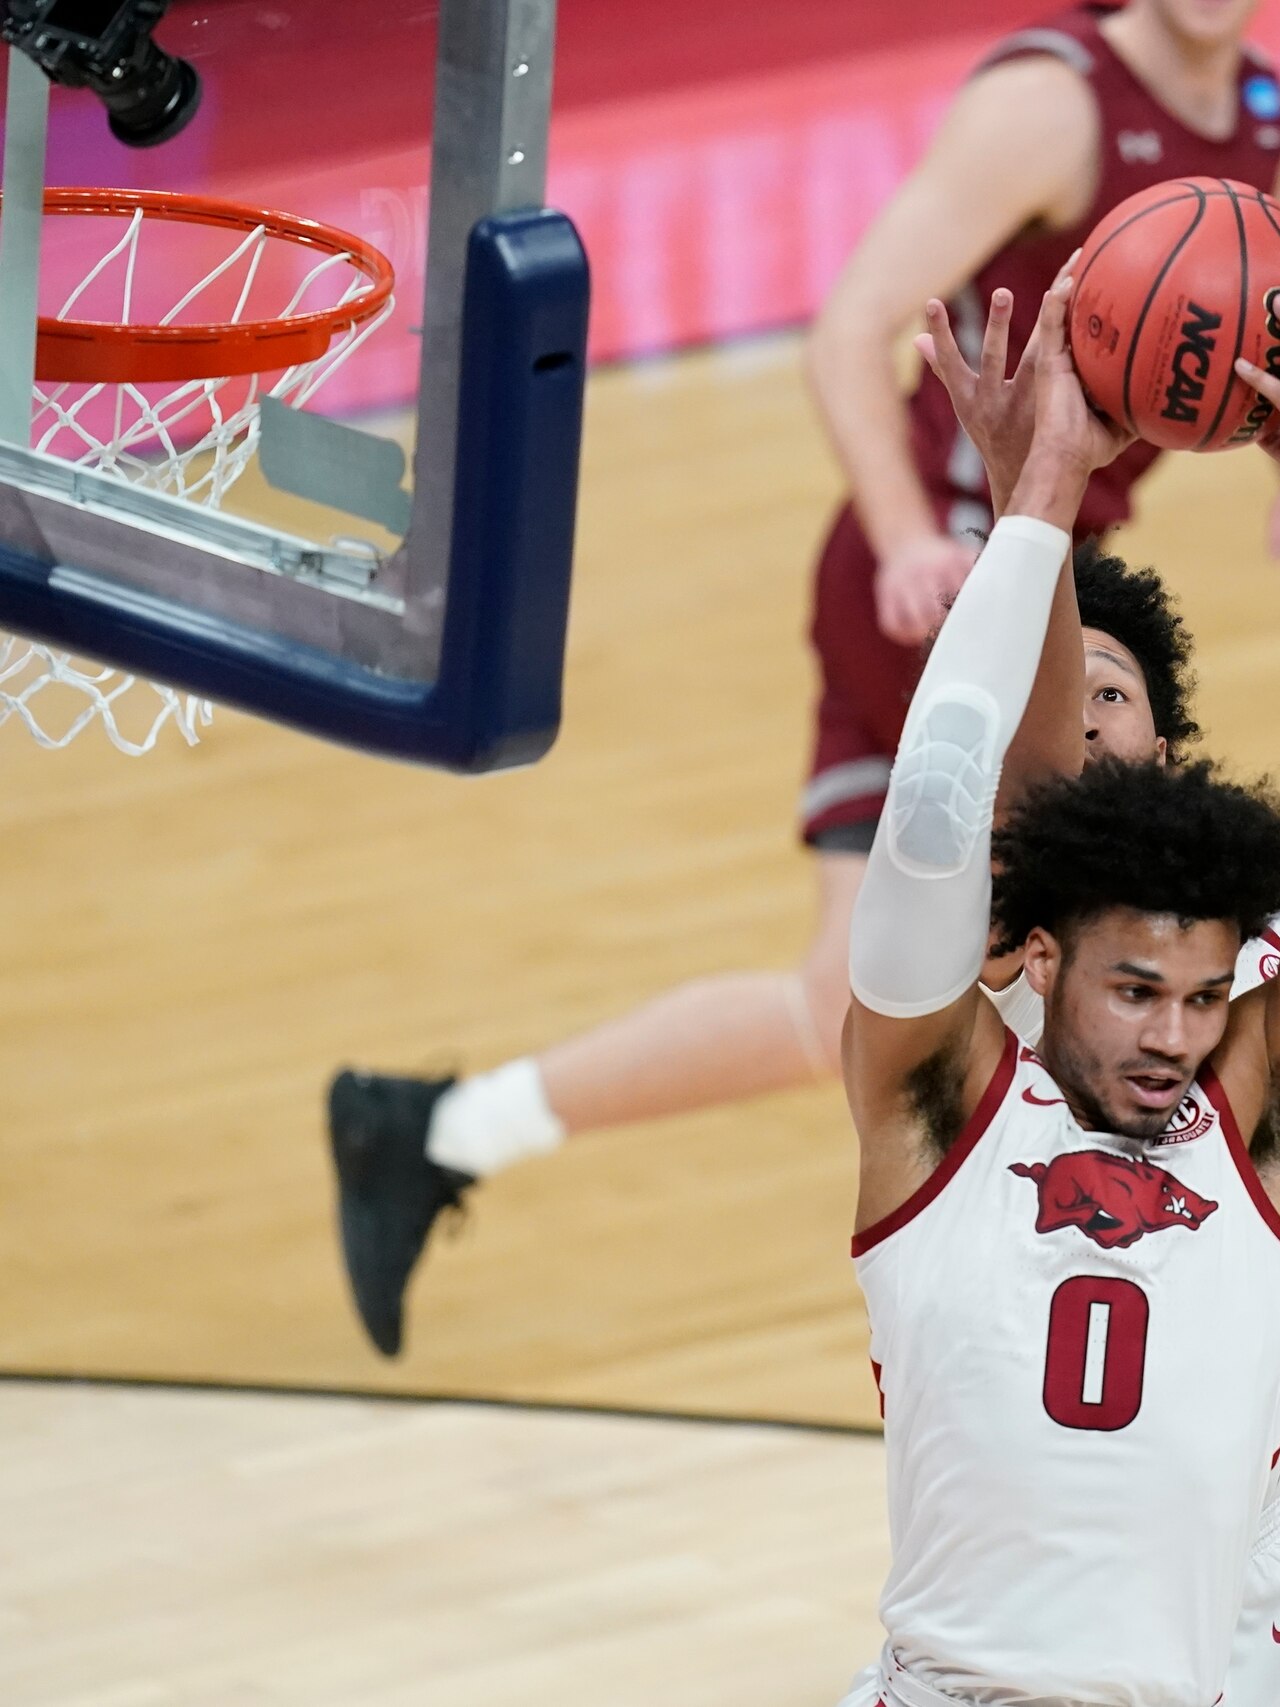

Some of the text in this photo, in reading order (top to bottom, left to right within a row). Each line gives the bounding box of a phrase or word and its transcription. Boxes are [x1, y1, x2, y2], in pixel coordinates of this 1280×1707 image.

[1160, 302, 1222, 423] NCAA
[1165, 1098, 1196, 1132] EC
[1043, 1275, 1149, 1431] 0
